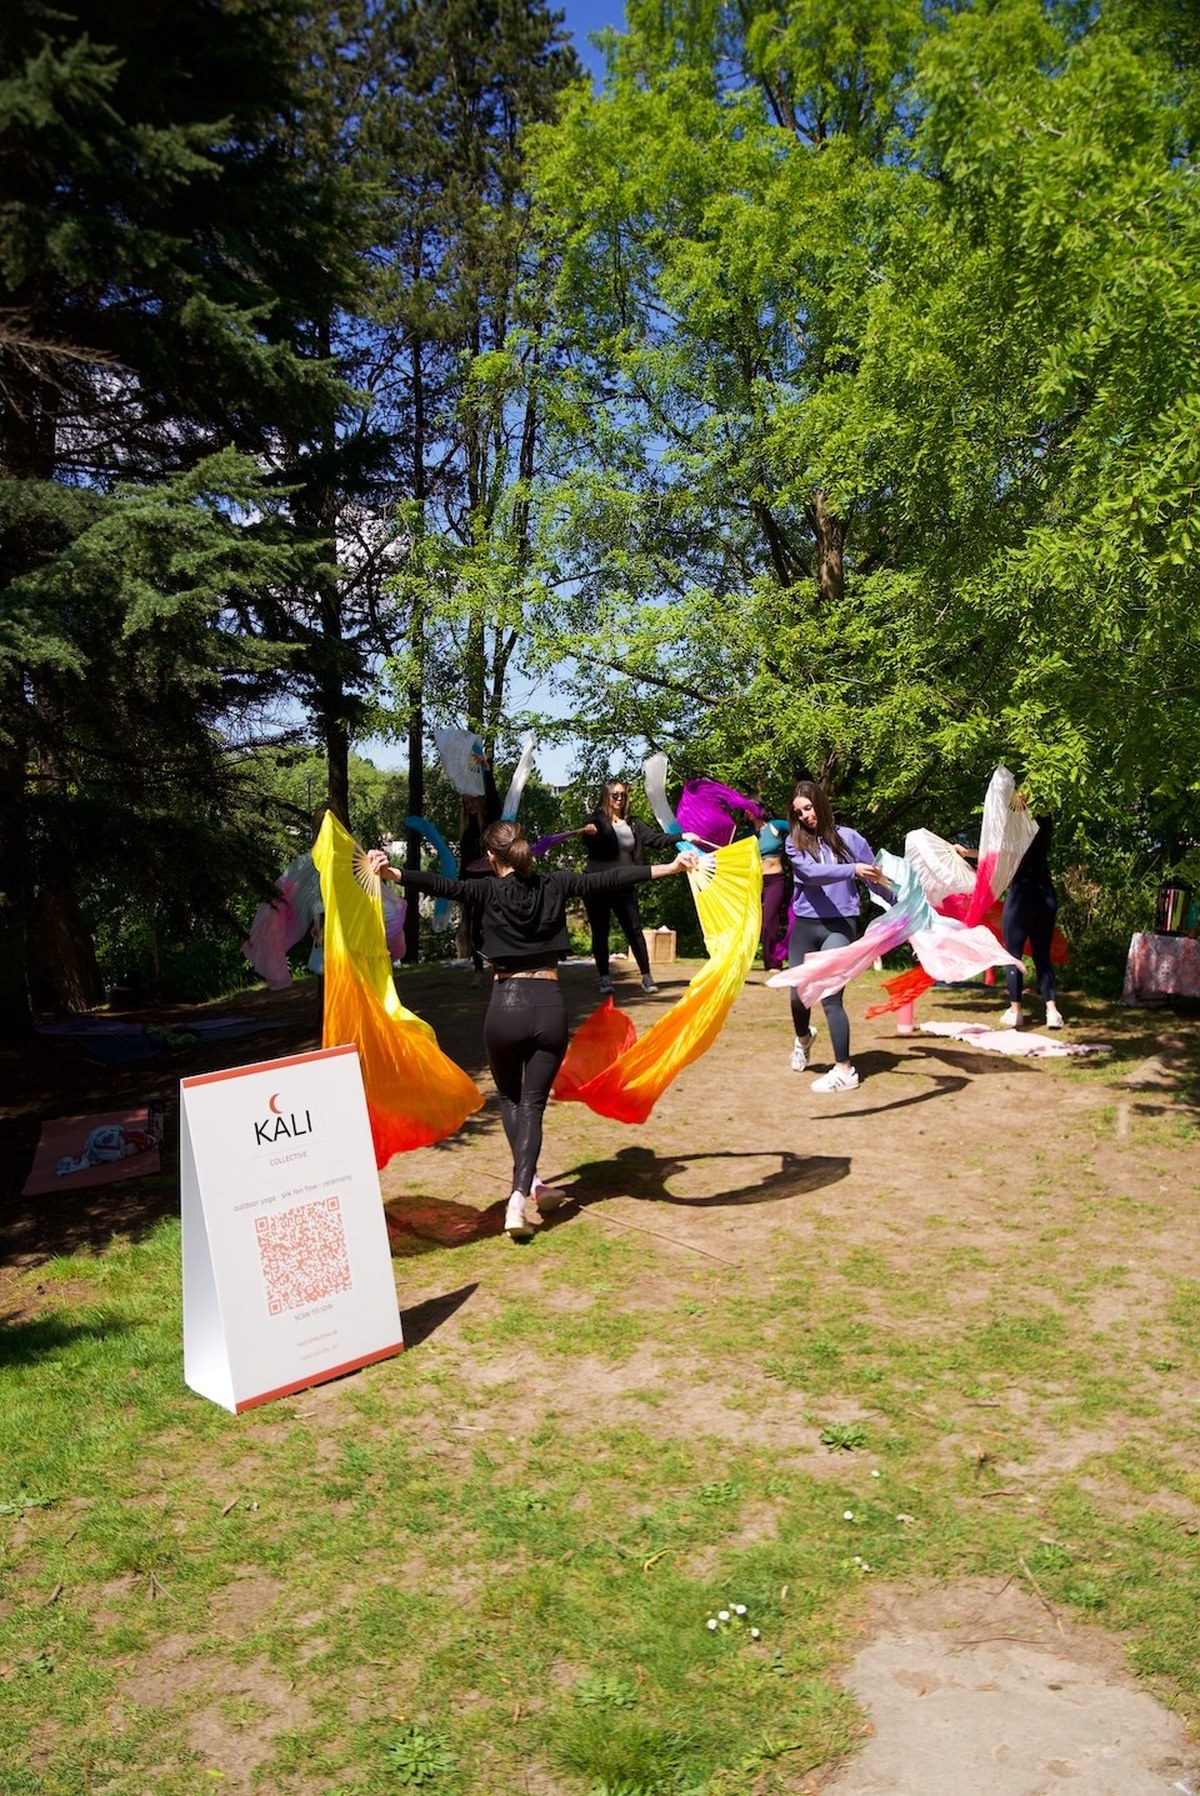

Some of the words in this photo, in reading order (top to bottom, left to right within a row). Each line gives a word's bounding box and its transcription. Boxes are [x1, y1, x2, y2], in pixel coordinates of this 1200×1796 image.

[254, 1109, 313, 1146] KALI
[269, 1151, 308, 1167] COLLECTIVE
[233, 1200, 260, 1212] outdoor
[260, 1195, 277, 1205] yoga
[281, 1190, 292, 1199] silk
[293, 1187, 304, 1195] fan
[304, 1183, 318, 1192] flow
[322, 1174, 352, 1187] ceremony
[294, 1311, 310, 1321] SCAN
